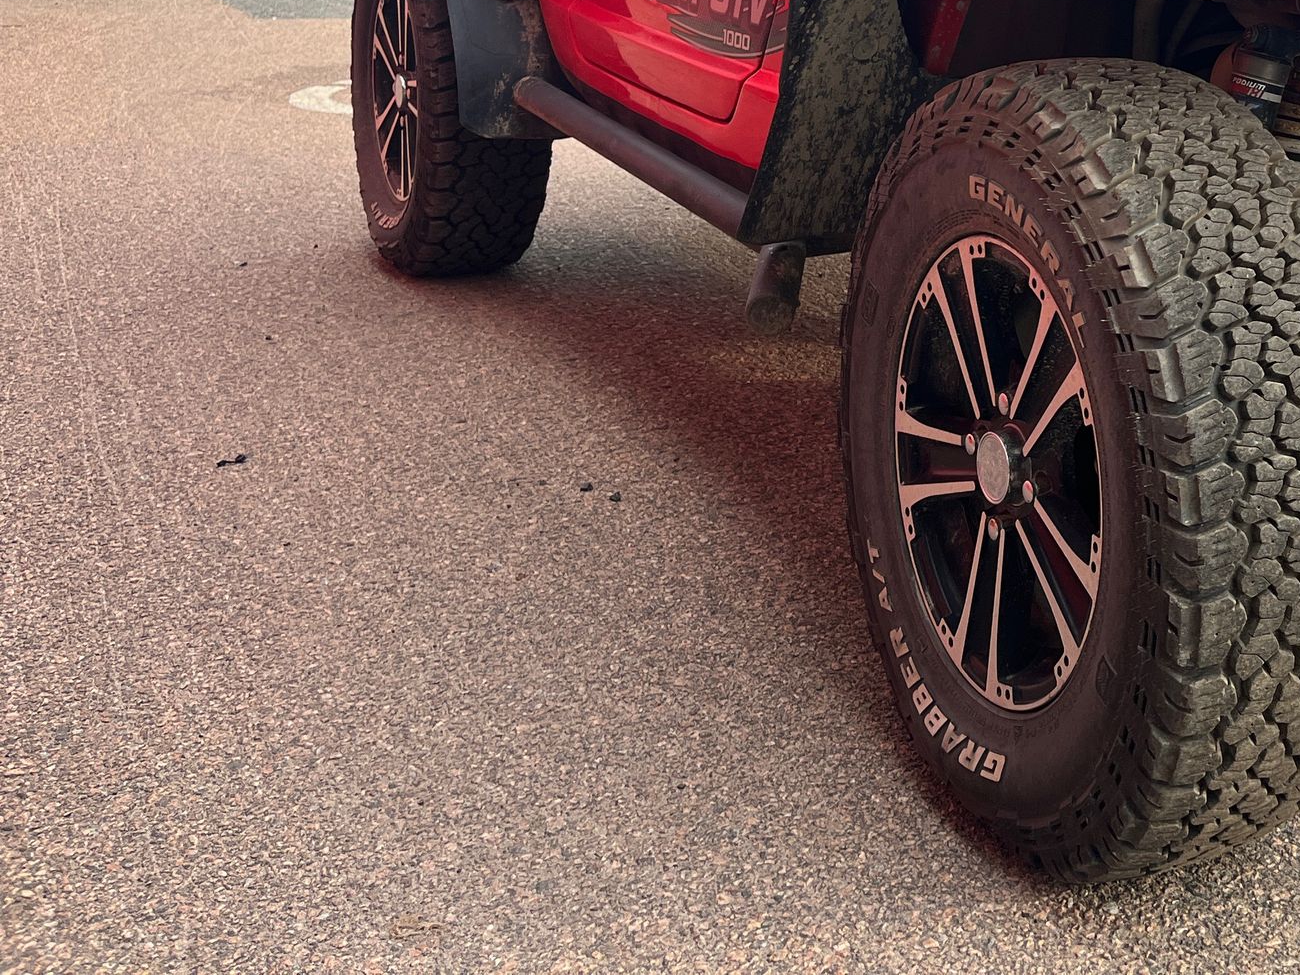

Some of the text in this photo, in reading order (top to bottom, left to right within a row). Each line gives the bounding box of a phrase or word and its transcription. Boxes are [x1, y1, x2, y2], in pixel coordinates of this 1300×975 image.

[722, 28, 751, 51] 1000
[967, 173, 1087, 350] GENERAL
[888, 626, 1006, 783] GRABBER
